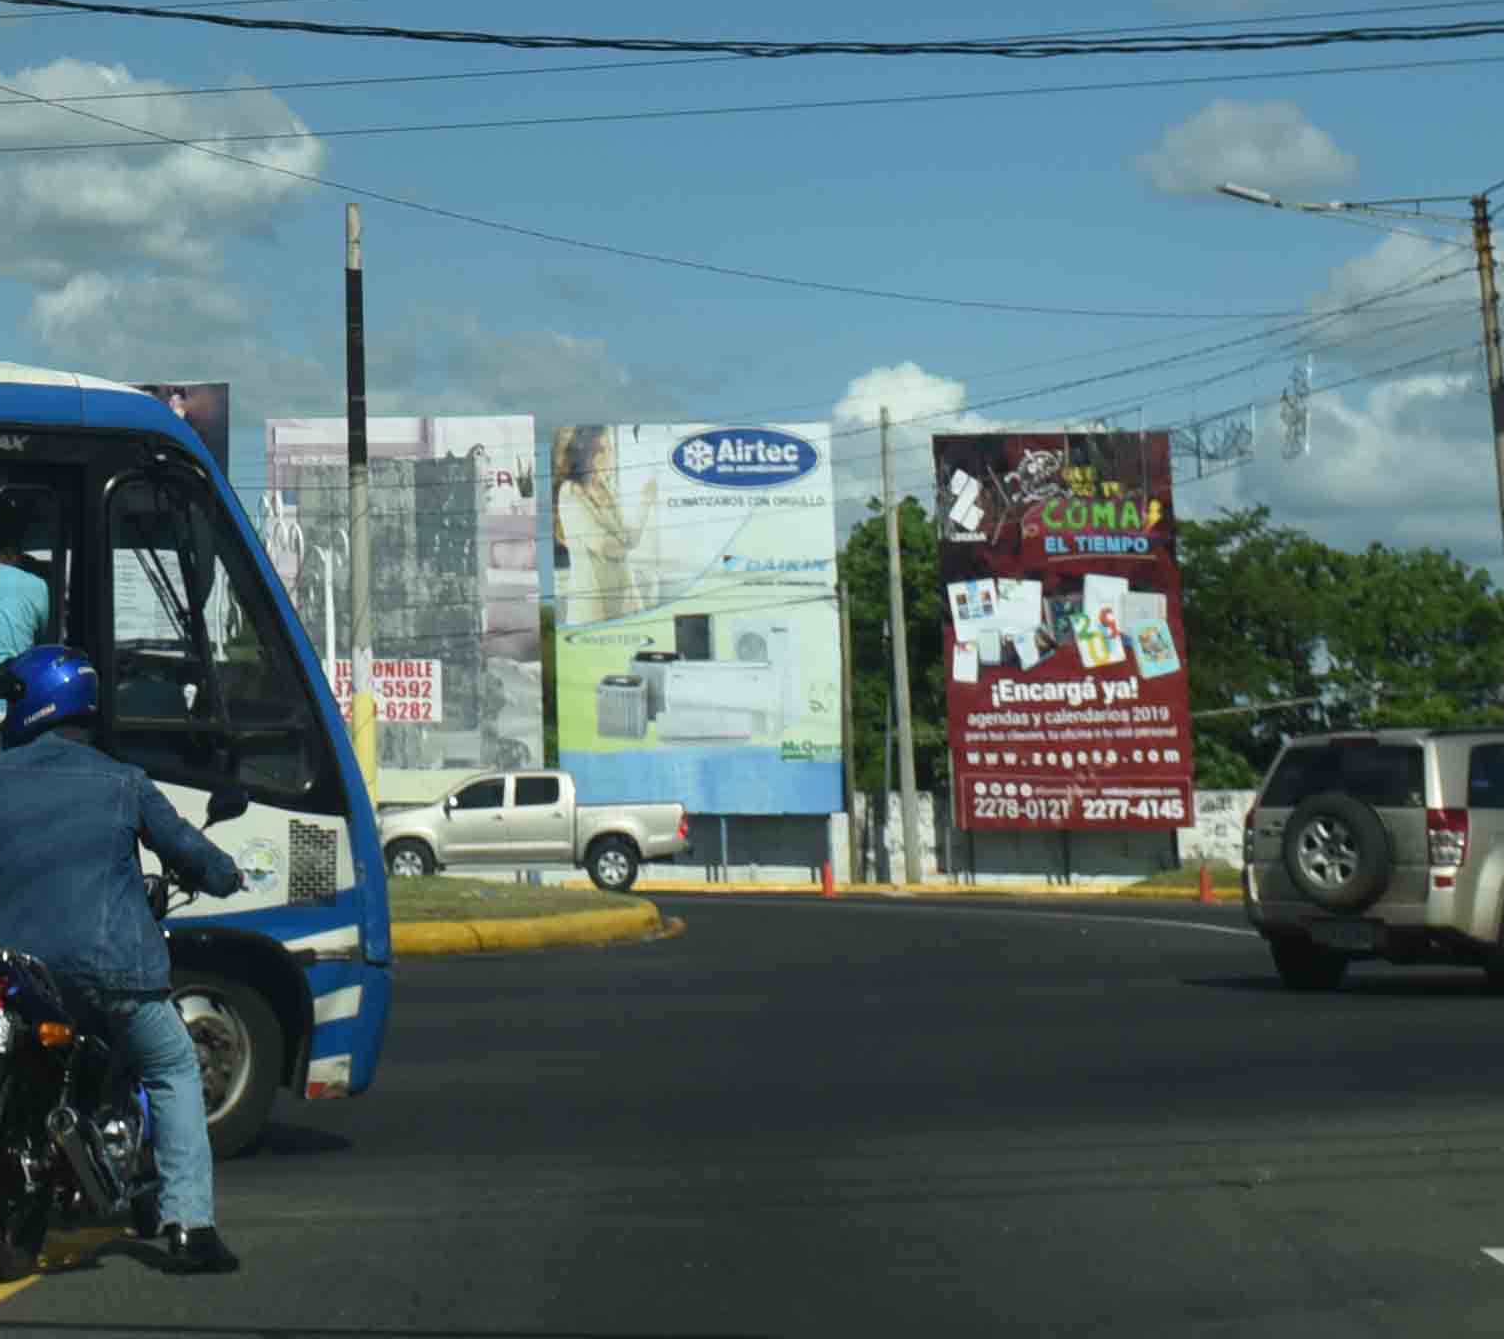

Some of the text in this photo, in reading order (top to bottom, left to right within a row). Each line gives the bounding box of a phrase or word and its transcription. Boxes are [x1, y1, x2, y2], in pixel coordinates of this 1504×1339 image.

[717, 438, 800, 463] Airtec
[1042, 501, 1141, 530] COMA
[1045, 535, 1149, 553] EL TIEMPO
[992, 676, 1139, 707] ¡Encargá ya!
[967, 710, 1028, 728] agendas
[1044, 707, 1130, 724] calendarios
[1082, 798, 1184, 820] 2277-4145
